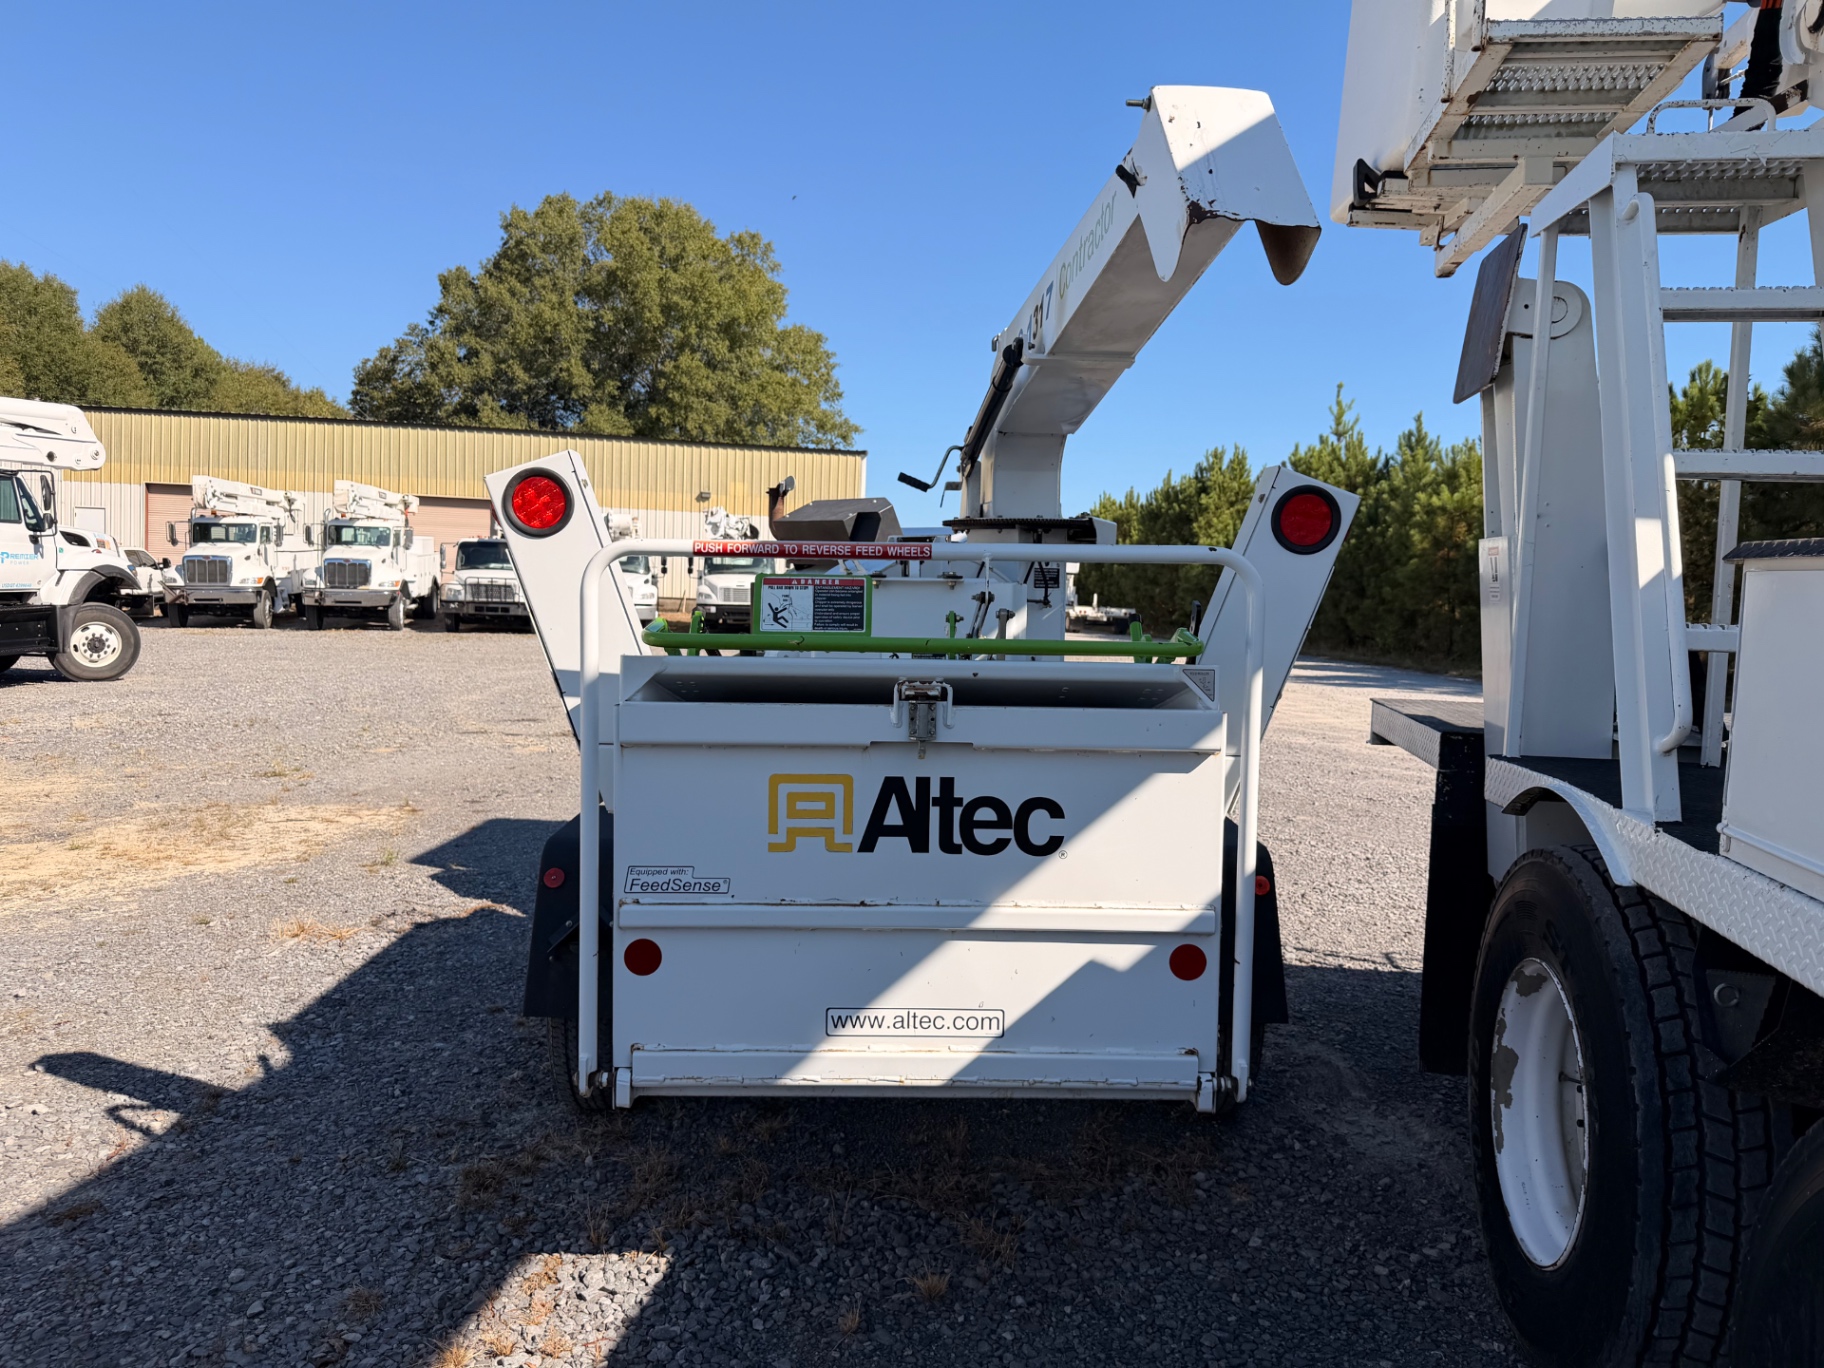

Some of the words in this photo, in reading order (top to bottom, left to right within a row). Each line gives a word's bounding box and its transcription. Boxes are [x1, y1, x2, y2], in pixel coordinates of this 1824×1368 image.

[1059, 190, 1117, 299] Contractor
[694, 542, 723, 553] PUSH
[727, 543, 779, 554] FORWARD
[784, 544, 798, 554] TO
[802, 544, 852, 556] REVERSE
[855, 545, 883, 556] FEED
[887, 546, 931, 557] WHEELS
[857, 776, 1065, 857] Altec
[629, 867, 668, 877] Equipped
[670, 868, 689, 876] with:
[831, 1010, 1000, 1031] www.altec.com
